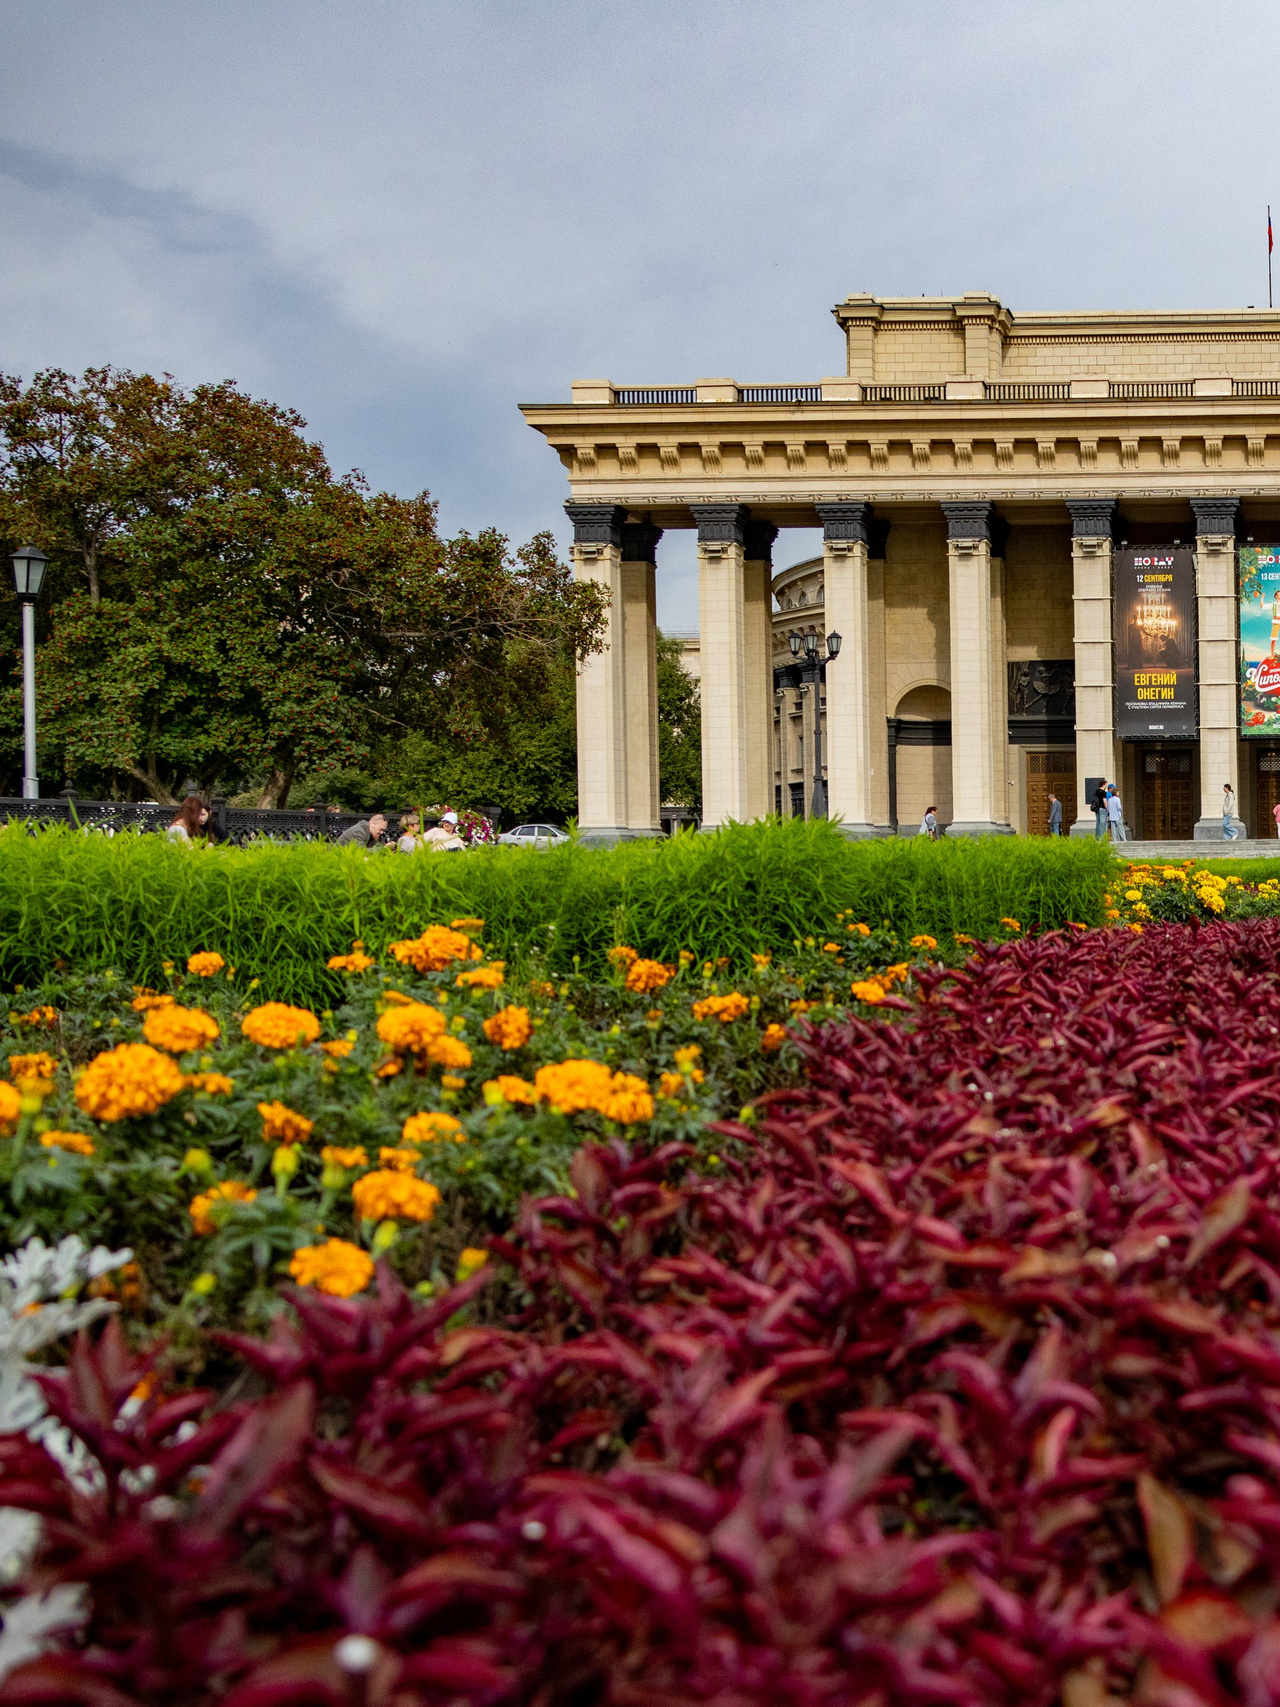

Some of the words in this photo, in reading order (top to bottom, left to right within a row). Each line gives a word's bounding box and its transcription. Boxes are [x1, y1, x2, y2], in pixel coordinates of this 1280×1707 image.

[1134, 556, 1174, 566] НОВАТ
[1136, 574, 1144, 583] 12
[1144, 574, 1173, 583] СЕНТЯБРЯ
[1261, 573, 1268, 581] 13
[1134, 671, 1177, 686] ЕВГЕНИЙ
[1137, 687, 1175, 700] ОНЕГИН
